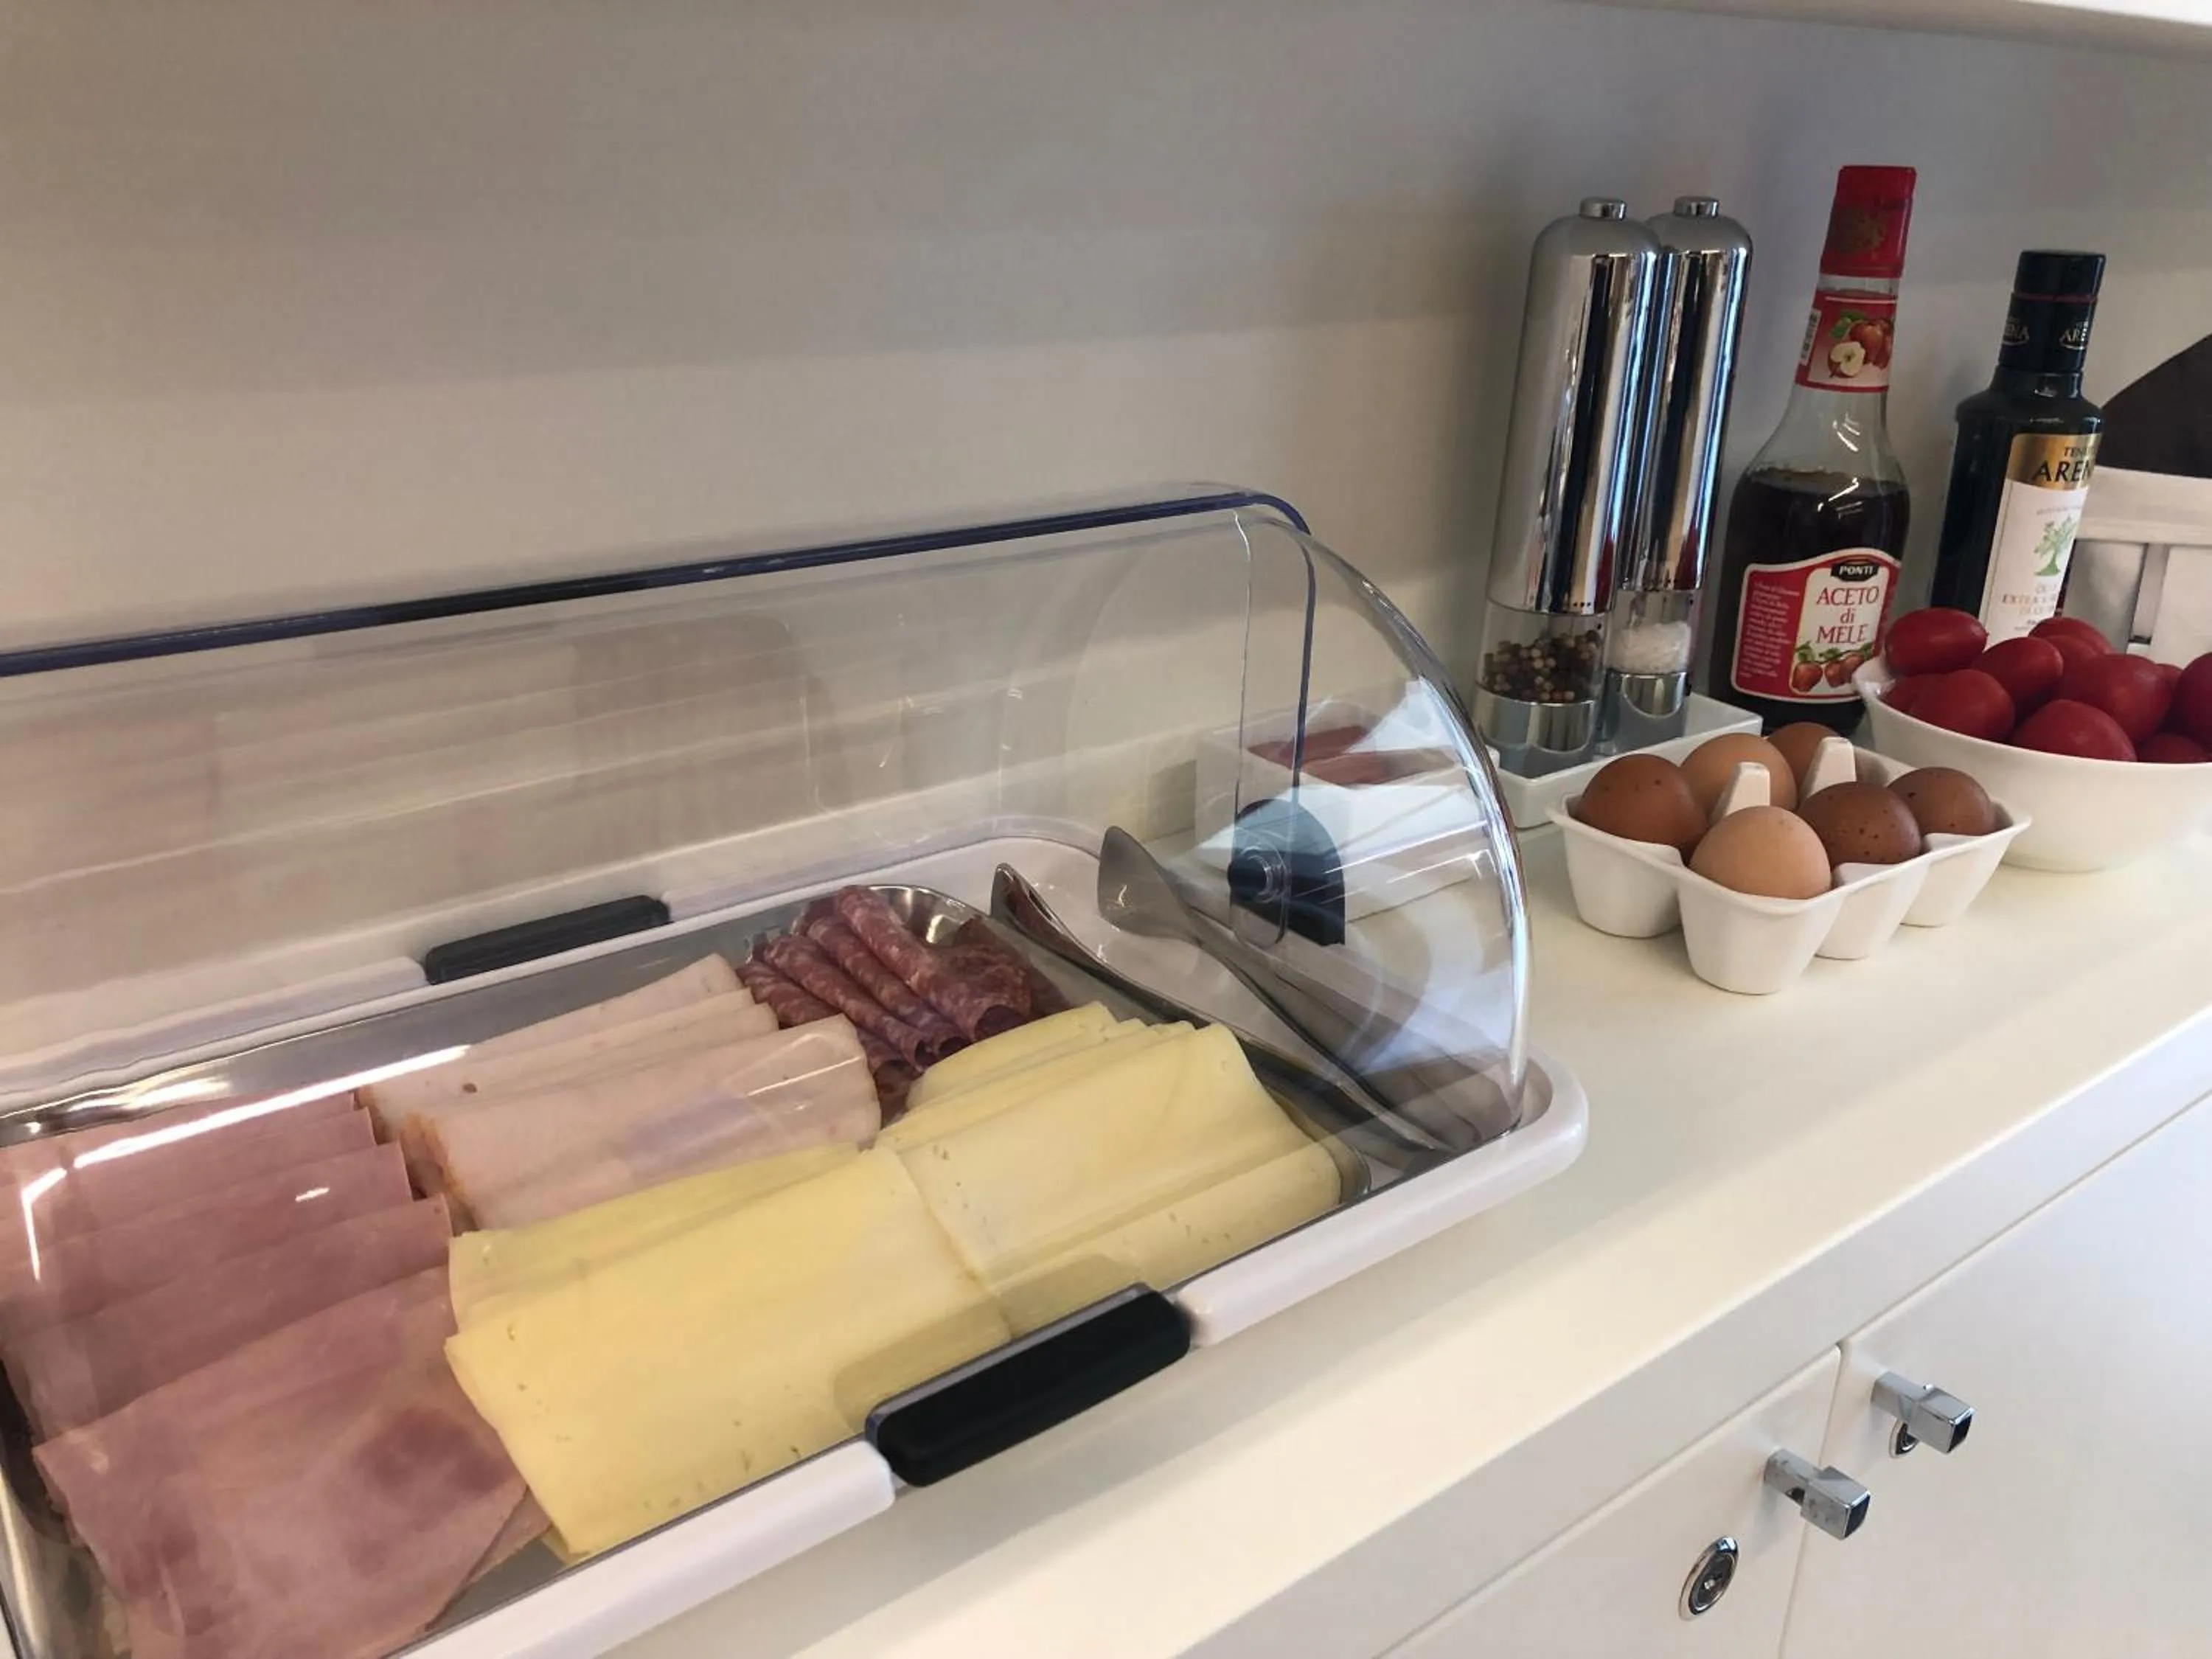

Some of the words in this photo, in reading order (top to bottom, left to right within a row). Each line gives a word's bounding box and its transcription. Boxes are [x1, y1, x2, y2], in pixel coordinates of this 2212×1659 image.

[1839, 565, 1874, 575] PONTI
[1816, 585, 1879, 606] ACETO
[1840, 608, 1857, 624] di
[1815, 623, 1869, 644] MELE
